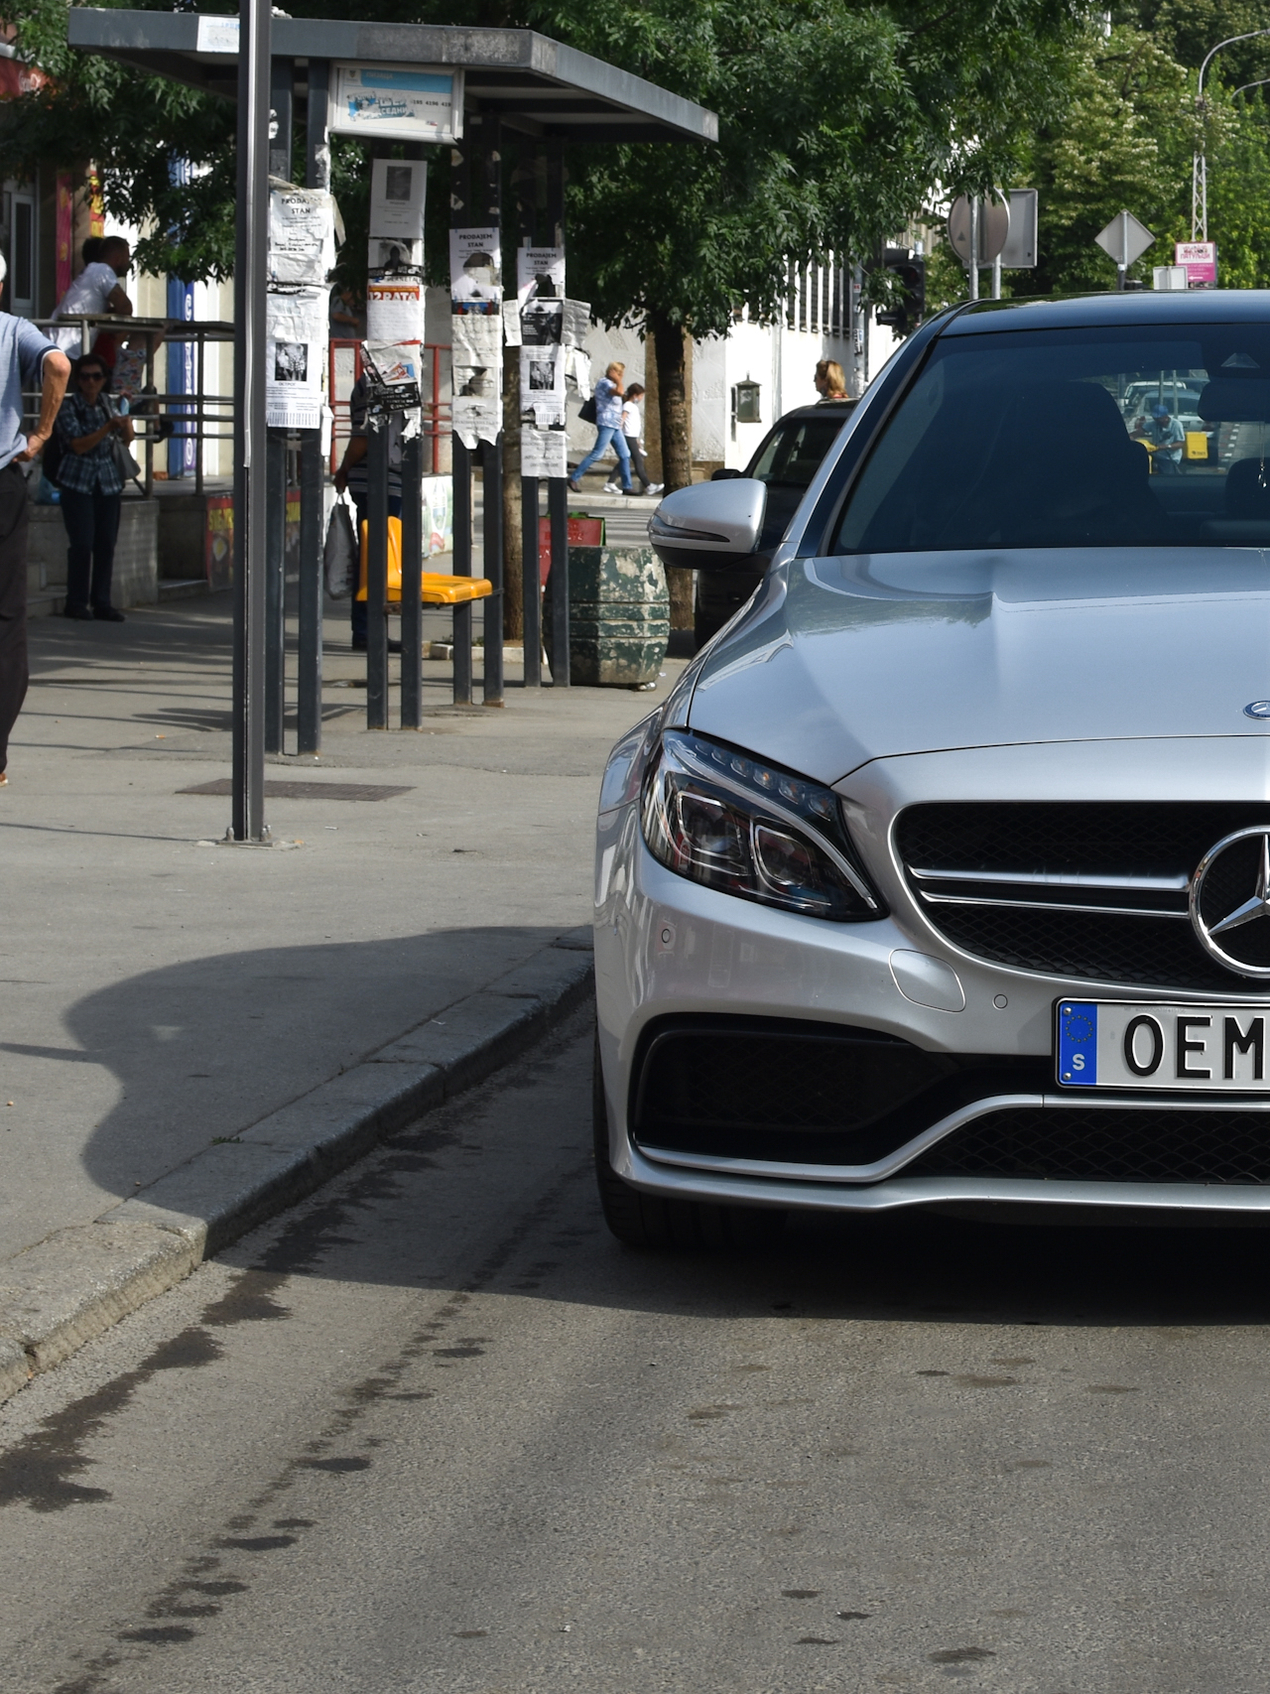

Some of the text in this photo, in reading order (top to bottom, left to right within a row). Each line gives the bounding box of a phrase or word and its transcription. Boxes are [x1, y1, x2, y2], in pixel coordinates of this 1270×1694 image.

[281, 197, 322, 205] PRODA
[1123, 1014, 1264, 1081] OEM
[1072, 1053, 1085, 1071] S
